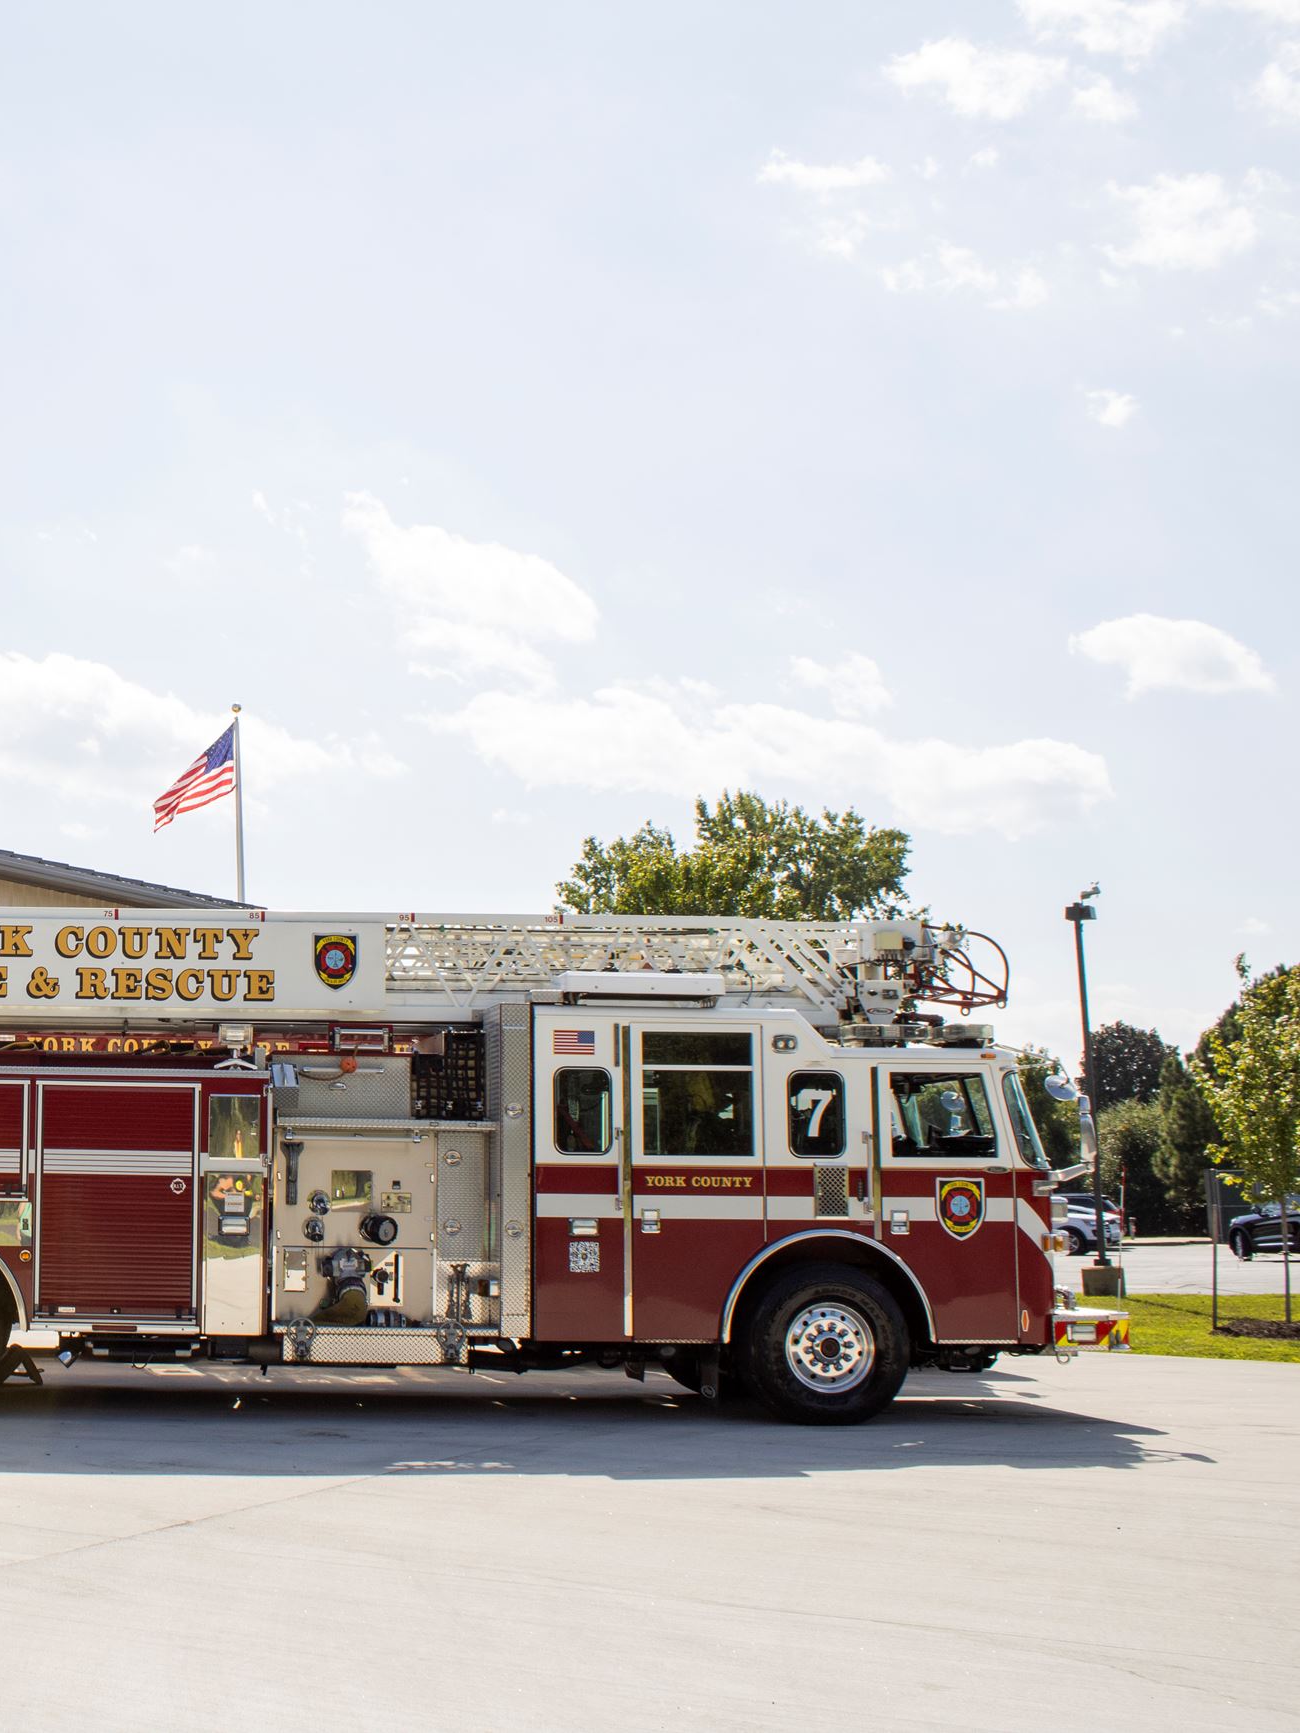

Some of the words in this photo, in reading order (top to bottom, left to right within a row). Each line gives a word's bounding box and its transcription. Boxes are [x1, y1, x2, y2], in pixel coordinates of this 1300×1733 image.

[103, 910, 114, 918] 75
[249, 911, 260, 919] 85
[55, 926, 259, 960] COUNTY
[26, 966, 60, 999] &
[75, 967, 275, 1001] RESCUE
[108, 1039, 213, 1053] COY
[802, 1089, 833, 1137] 7
[645, 1176, 686, 1187] YORK
[692, 1176, 753, 1187] COUNTY
